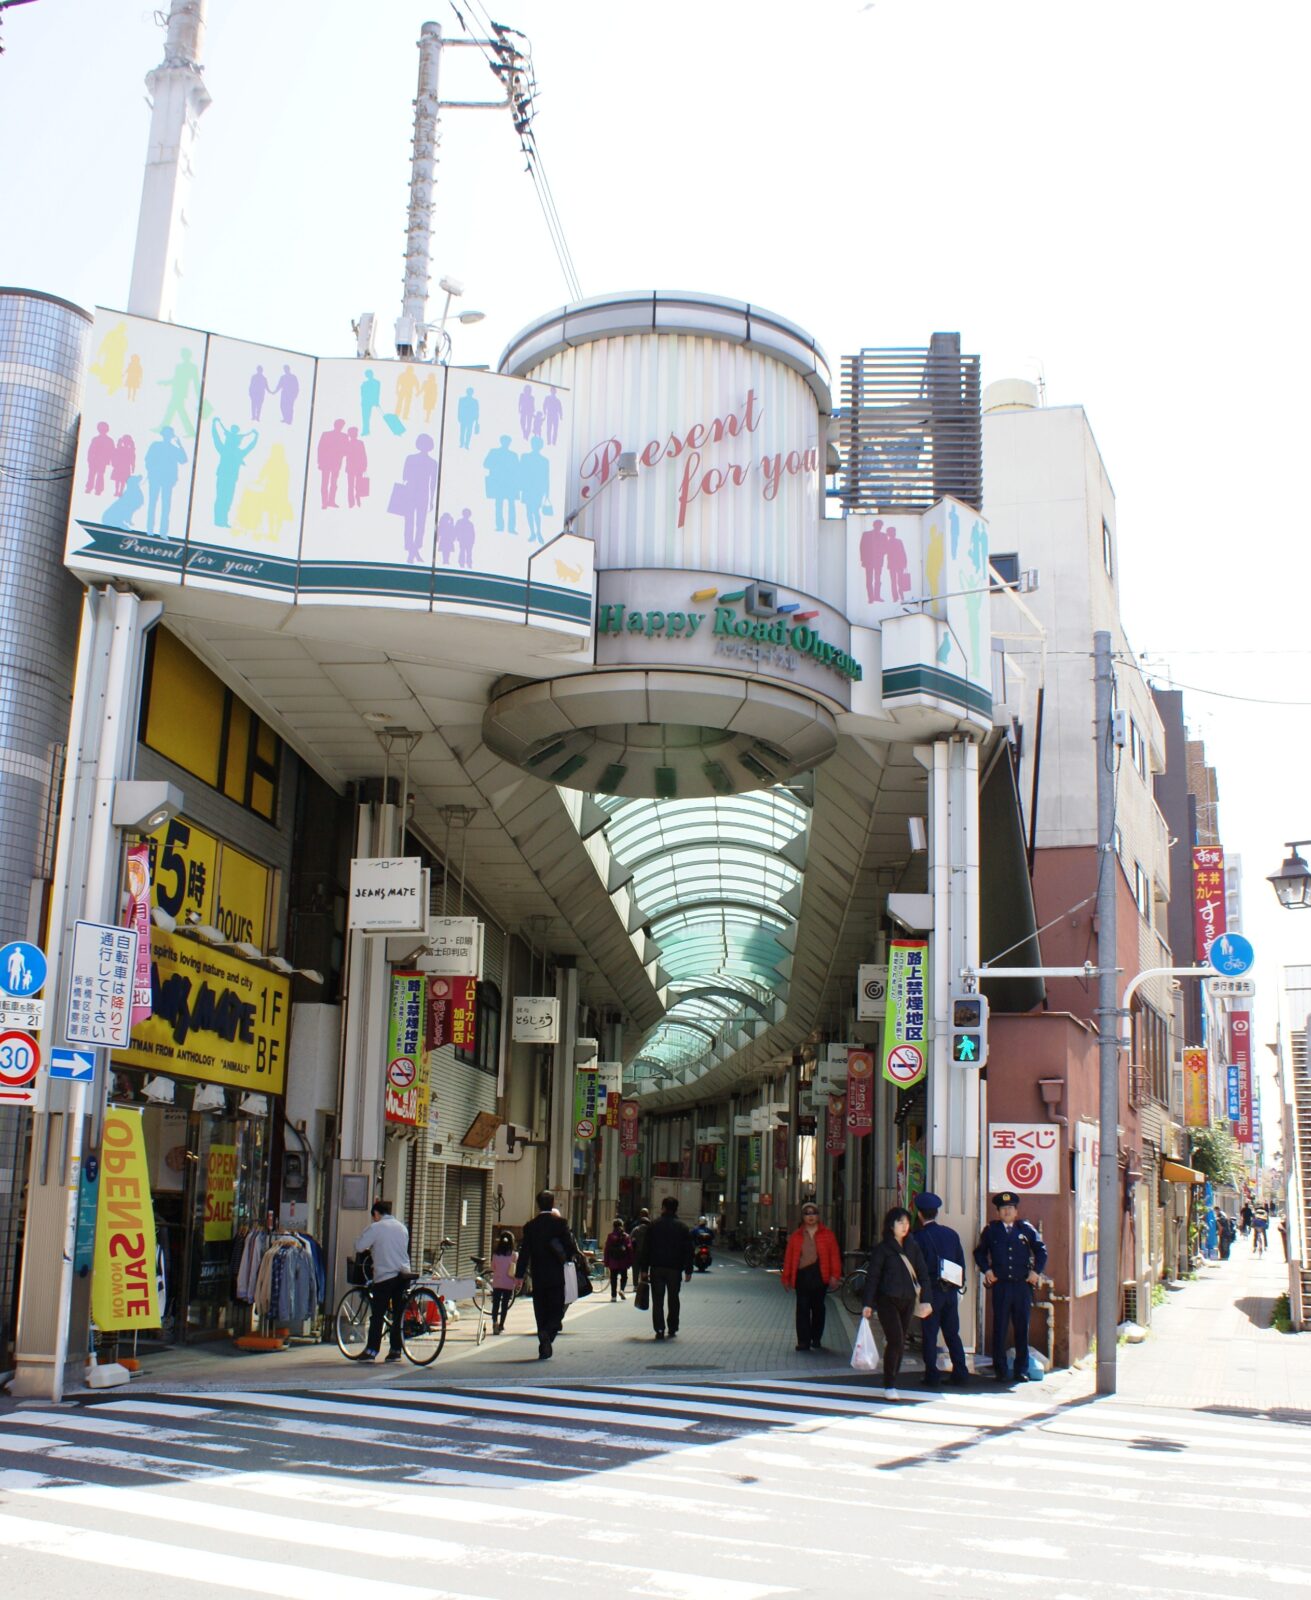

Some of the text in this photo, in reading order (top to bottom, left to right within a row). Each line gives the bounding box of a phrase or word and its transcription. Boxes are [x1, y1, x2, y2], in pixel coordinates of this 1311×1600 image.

[579, 389, 764, 498] Pesent
[678, 447, 818, 528] for you
[119, 536, 264, 574] Present for you!
[600, 604, 863, 682] Happy Road Ohyama
[355, 887, 416, 900] JEANS MATE
[1197, 872, 1220, 885] 牛丼
[1197, 886, 1221, 899] カレー
[216, 895, 253, 943] hours
[92, 931, 114, 1038] 通行して下さい
[154, 944, 253, 991] spirits loving nature and city
[0, 1001, 41, 1013] 転車を除く
[80, 977, 93, 1035] 板橋区役所
[110, 936, 130, 1040] 自転車は降りて
[261, 987, 282, 1026] 1F
[904, 951, 923, 1041] 路上禁煙地区
[28, 1015, 38, 1026] 21
[404, 980, 420, 1054] 路上禁煙地区
[453, 1008, 464, 1043] 加盟店
[465, 980, 476, 1043] ハローカード
[0, 1046, 29, 1070] 30
[155, 1044, 174, 1058] FROM
[177, 1050, 215, 1067] ANTHOLOGY
[256, 1036, 279, 1075] BF
[992, 1130, 1056, 1149] 宝くじ
[208, 1153, 236, 1175] OPEN
[208, 1177, 224, 1191] NOW
[205, 1194, 232, 1221] SALE
